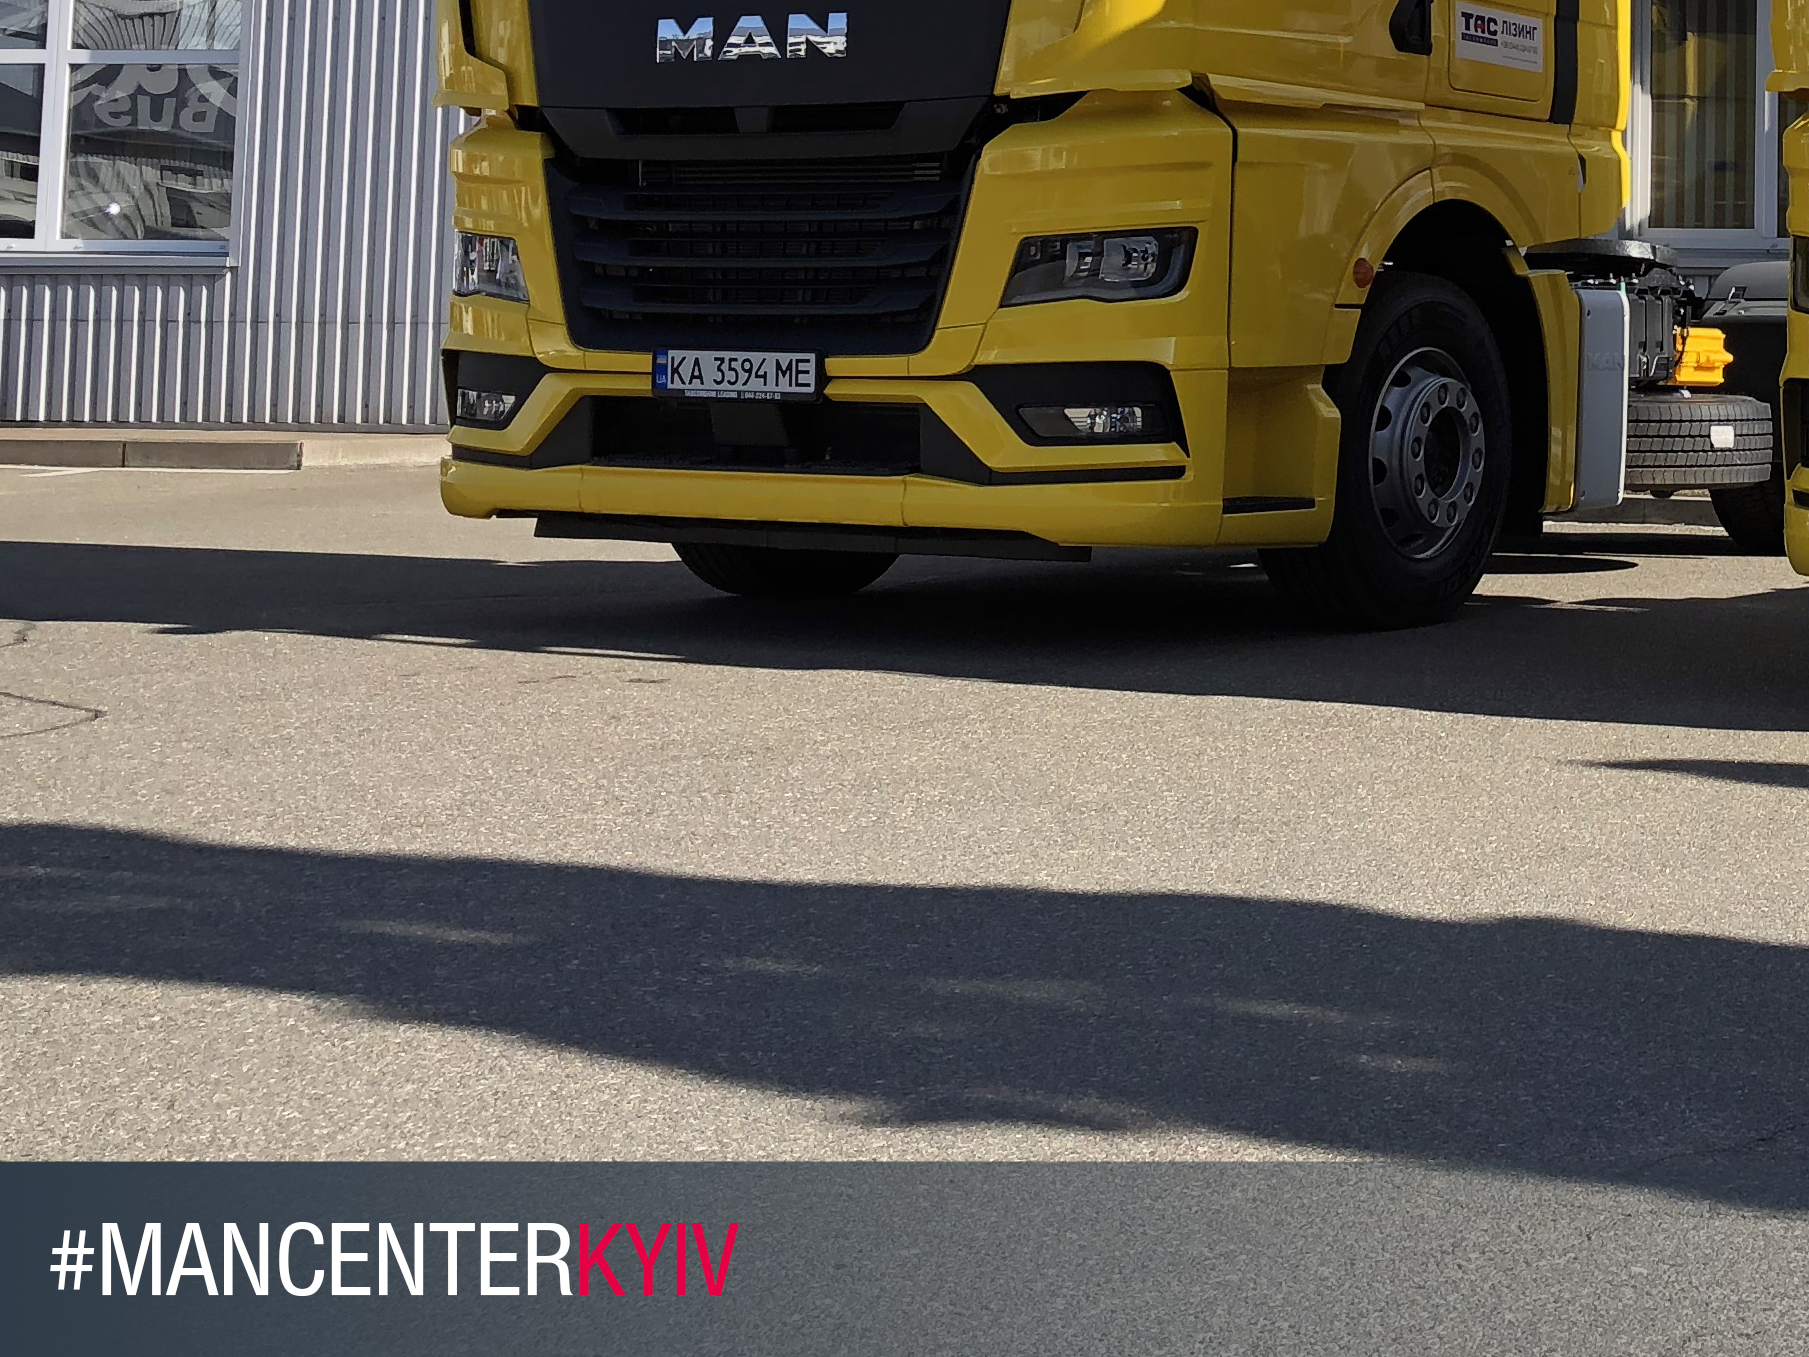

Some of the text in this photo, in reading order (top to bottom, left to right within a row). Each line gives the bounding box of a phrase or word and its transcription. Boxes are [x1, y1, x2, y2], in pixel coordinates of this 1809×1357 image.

[656, 11, 848, 63] MAN
[1501, 20, 1538, 42] ЛІЗИНГ
[670, 356, 811, 388] KA 3594 ME
